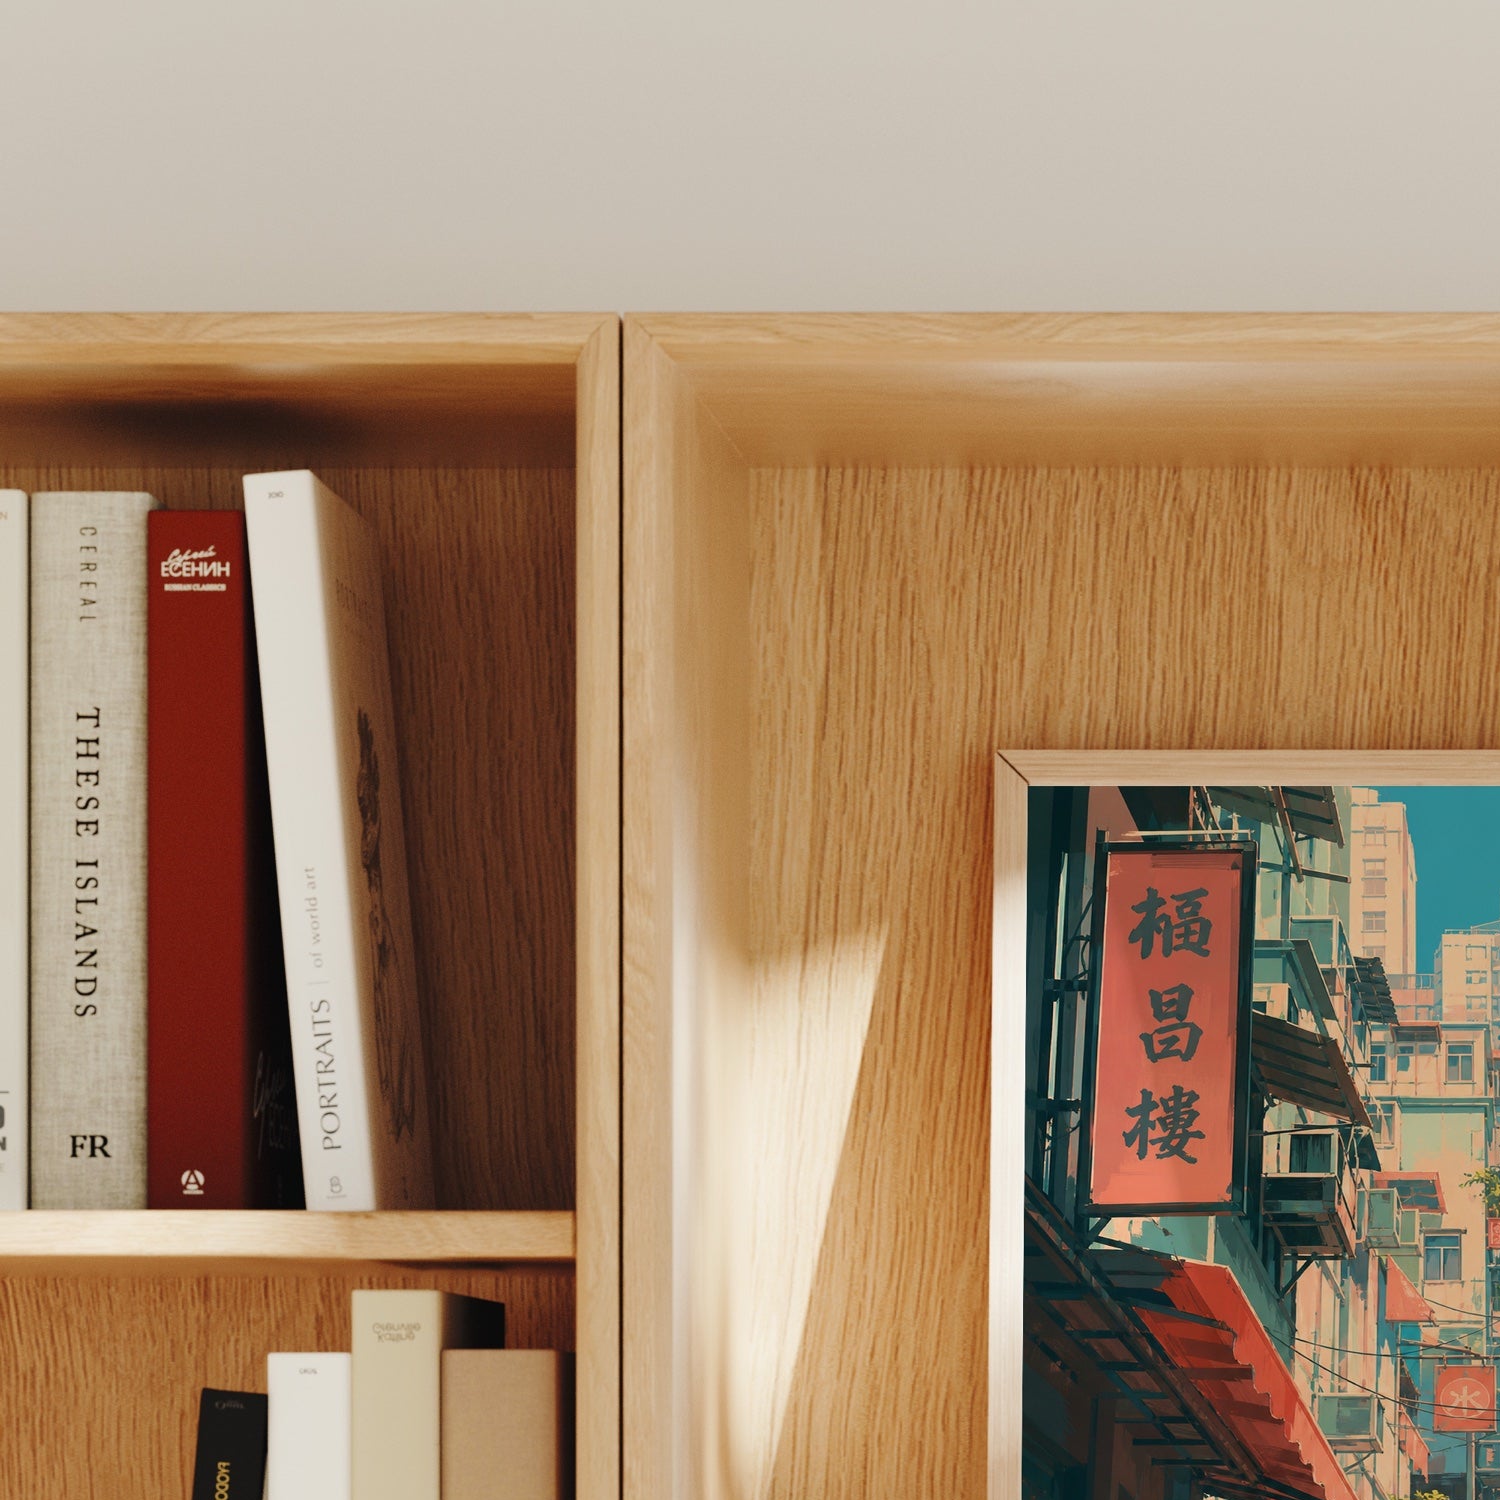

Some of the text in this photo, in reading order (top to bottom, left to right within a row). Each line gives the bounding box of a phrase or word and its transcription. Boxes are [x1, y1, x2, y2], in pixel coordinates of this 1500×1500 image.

[79, 526, 98, 623] CEREAL
[161, 561, 230, 577] ЕСЕНИН
[74, 706, 101, 1017] THESE ISLANDS
[303, 866, 342, 1150] PORTRAITS of world art
[69, 1134, 112, 1158] FR
